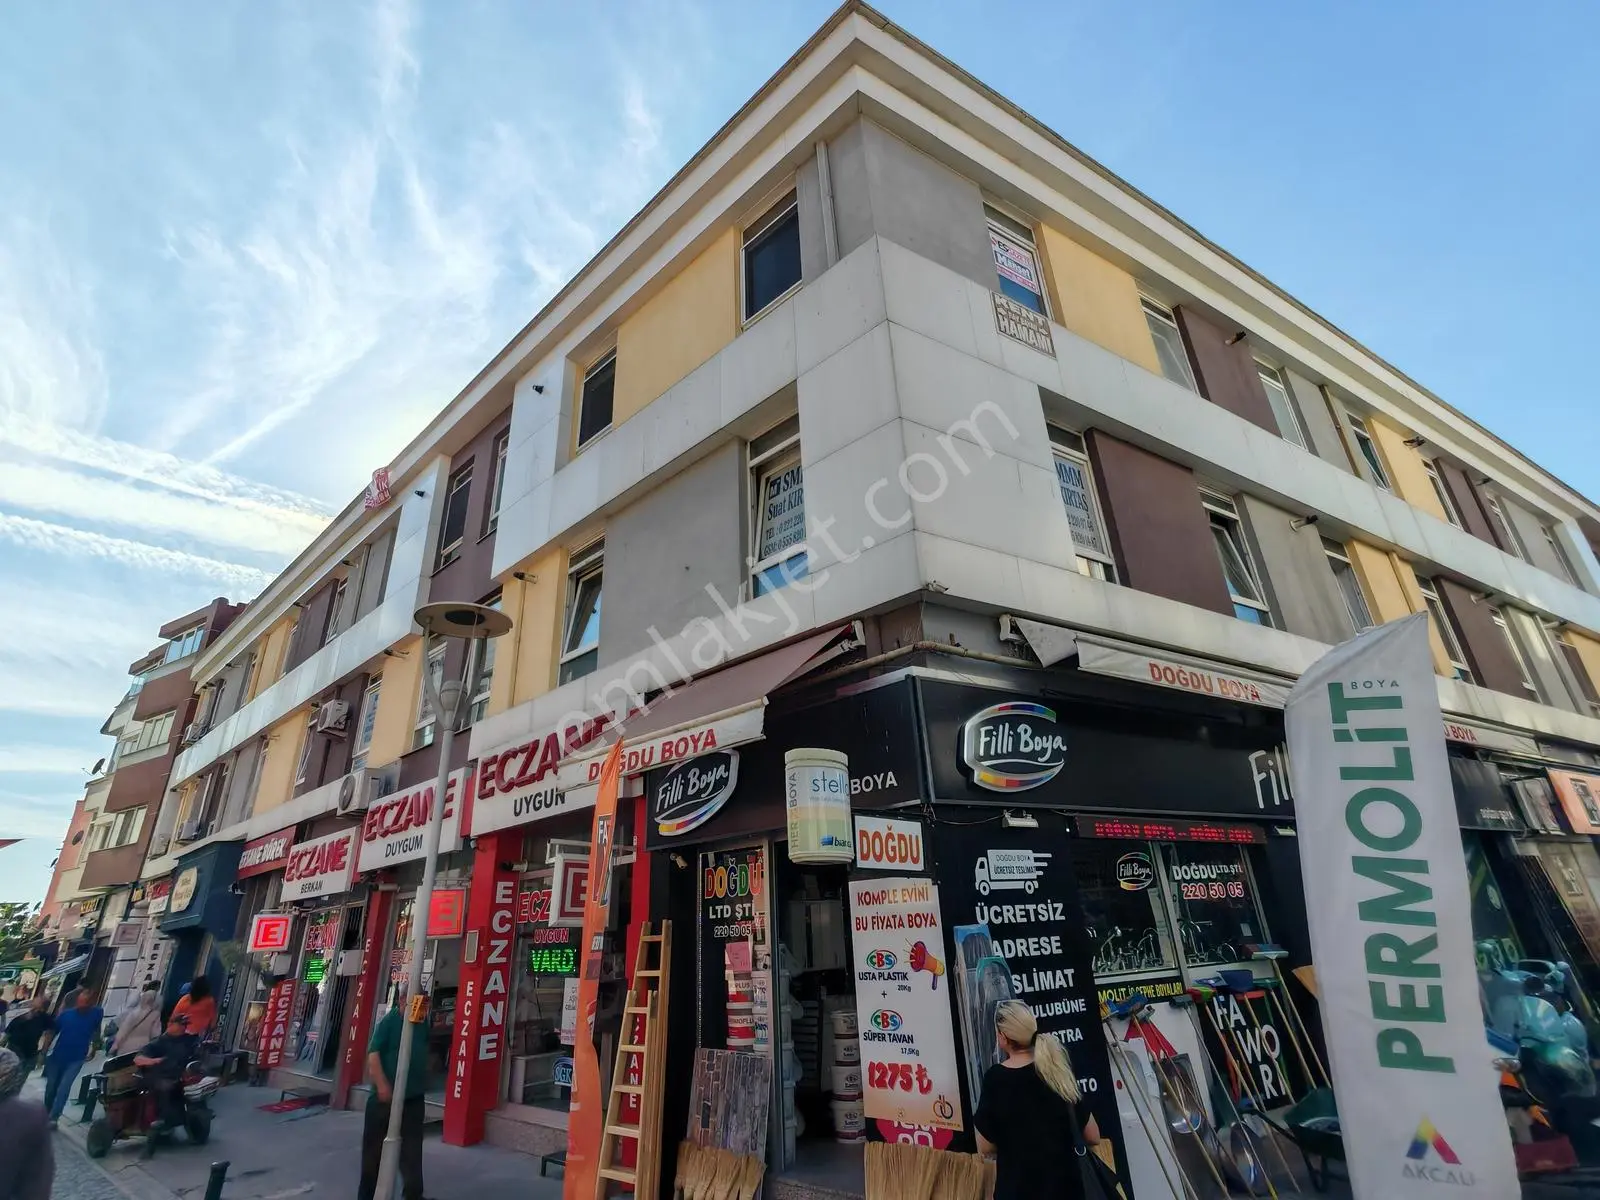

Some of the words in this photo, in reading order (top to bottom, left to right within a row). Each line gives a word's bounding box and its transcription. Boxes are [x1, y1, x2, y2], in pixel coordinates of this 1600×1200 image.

[767, 499, 786, 521] Suat
[1149, 662, 1214, 693] DOĞDU
[1351, 679, 1400, 690] BOYA
[979, 722, 1014, 757] Filli
[1016, 723, 1067, 763] Boya
[1449, 725, 1478, 742] BOYA
[660, 728, 718, 764] BOYA
[656, 774, 684, 813] Filli
[687, 764, 729, 798] Boya
[850, 771, 898, 795] BOYA
[364, 778, 456, 842] ECZANE
[513, 788, 566, 817] UYGUN
[385, 834, 423, 858] DUYGUM
[858, 825, 920, 865] DOĞDU
[285, 836, 351, 883] ECZANE
[1120, 863, 1132, 877] Filli
[1132, 862, 1152, 879] Boya
[1172, 862, 1217, 880] DOĞDU
[300, 880, 323, 894] BERKAN
[704, 858, 762, 899] DOĞDU
[1328, 682, 1456, 1074] PERMOLİT
[857, 888, 898, 906] KOMPLE
[901, 882, 929, 904] EVİNİ
[1181, 882, 1207, 900] 220
[1208, 882, 1226, 898] 50
[1226, 881, 1245, 898] 05
[709, 905, 732, 919] LTD
[855, 915, 868, 932] BU
[871, 912, 905, 931] FİYATA
[907, 912, 937, 929] BOYA
[975, 899, 1066, 925] ÜCRETSİZ
[261, 923, 281, 943] E
[533, 927, 569, 943] UYGUN
[713, 925, 729, 938] 220
[729, 925, 740, 937] 50
[740, 924, 752, 936] 05
[991, 935, 1063, 959] ADRESE
[479, 881, 514, 1061] ECZANE
[868, 952, 895, 968] CBS
[858, 971, 876, 981] USTA
[897, 984, 912, 992] 20Kg
[345, 938, 372, 1064] ECZANE
[267, 983, 293, 1064] ECZANE
[873, 1012, 898, 1029] CBS
[453, 980, 474, 1099] ECZANE
[863, 1030, 886, 1043] SÜPER
[888, 1033, 914, 1044] TAVAN
[555, 1066, 572, 1083] SGK
[868, 1061, 913, 1093] 1275
